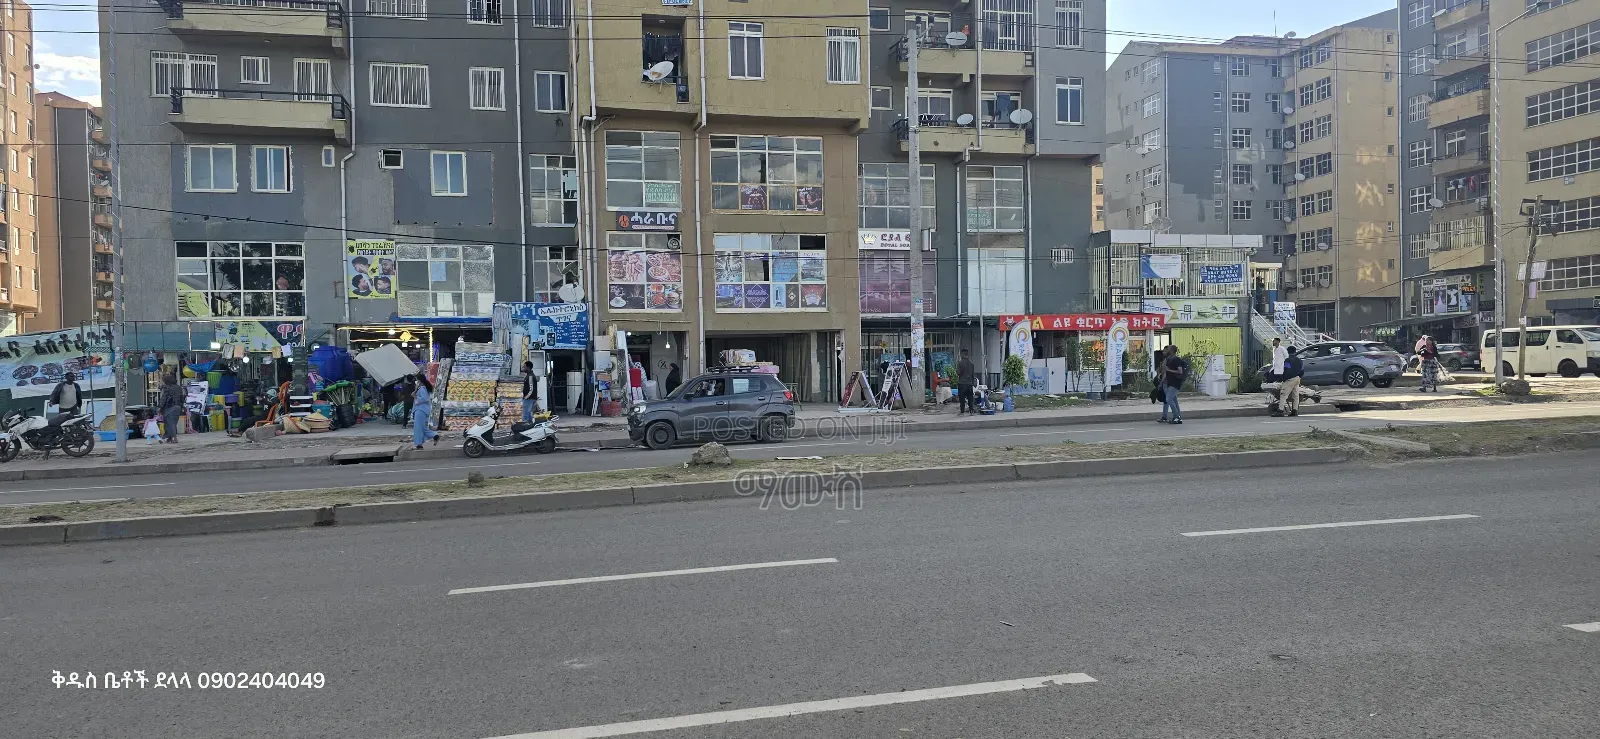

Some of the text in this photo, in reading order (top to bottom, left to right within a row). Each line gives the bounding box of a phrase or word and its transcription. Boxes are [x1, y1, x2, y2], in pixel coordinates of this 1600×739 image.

[656, 212, 678, 225] ቡና
[1053, 317, 1071, 328] ልዩ
[1075, 317, 1106, 329] ቁርጥ
[1133, 317, 1161, 328] ክትፎ
